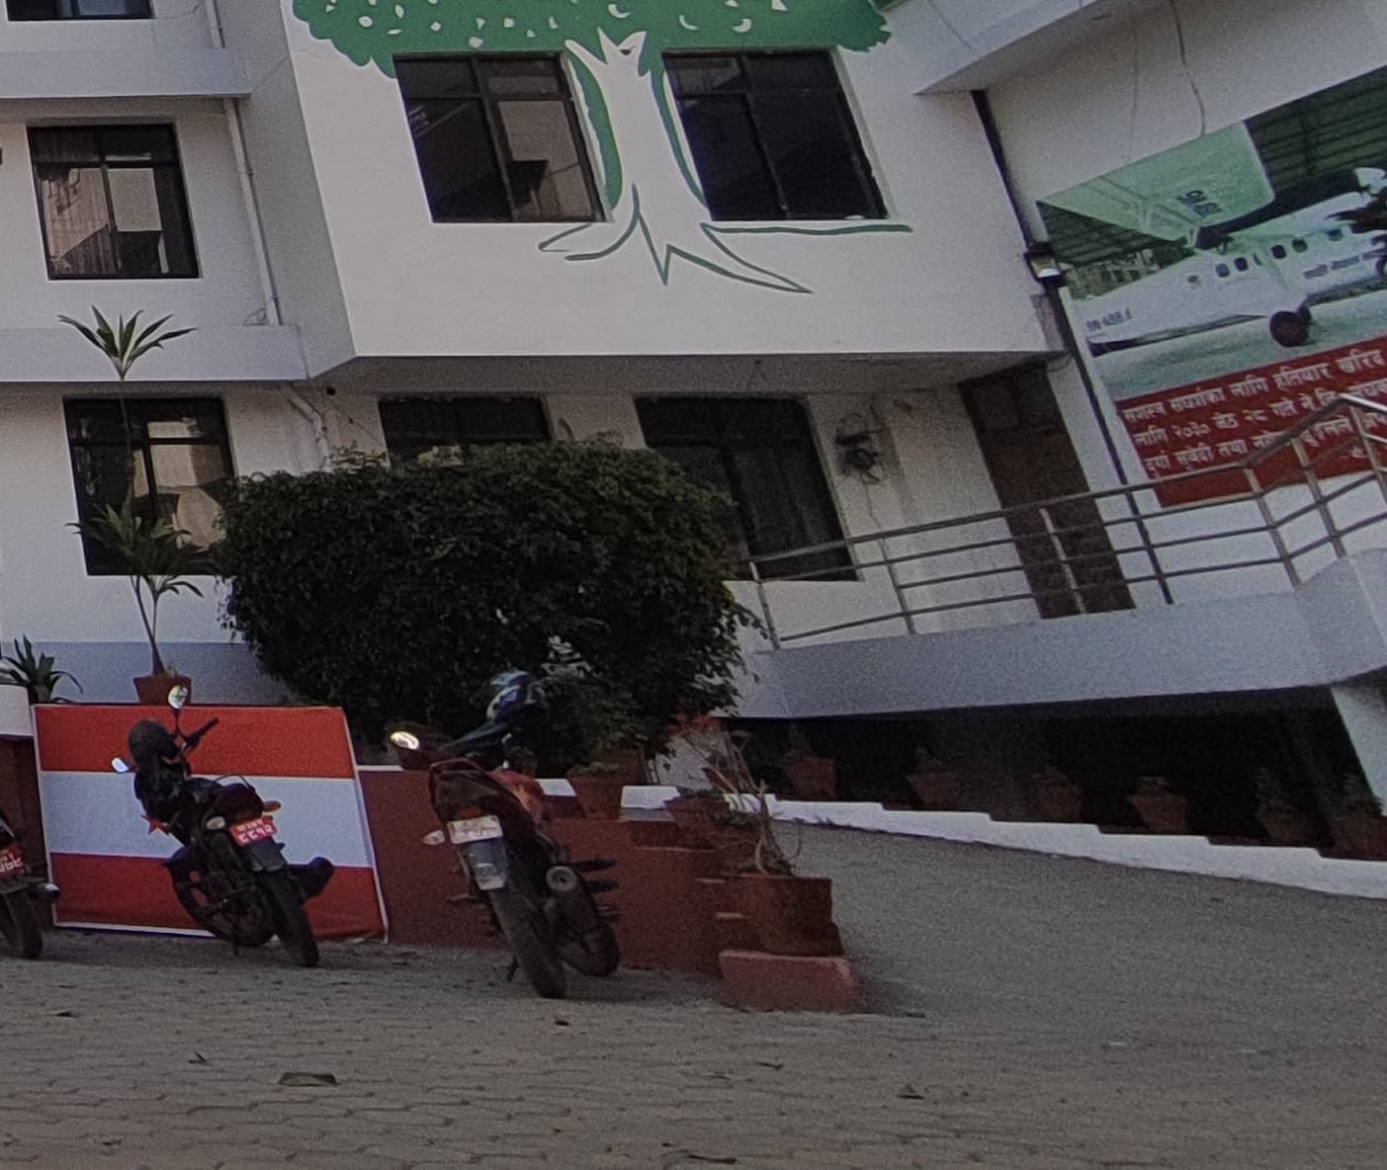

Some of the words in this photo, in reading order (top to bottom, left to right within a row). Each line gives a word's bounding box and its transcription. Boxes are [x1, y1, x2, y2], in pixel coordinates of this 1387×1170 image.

[1228, 374, 1270, 398] लागि
[1272, 365, 1334, 392] हतियार
[1132, 424, 1169, 447] लागि
[1269, 396, 1299, 417] गते
[1216, 438, 1249, 458] तथा
